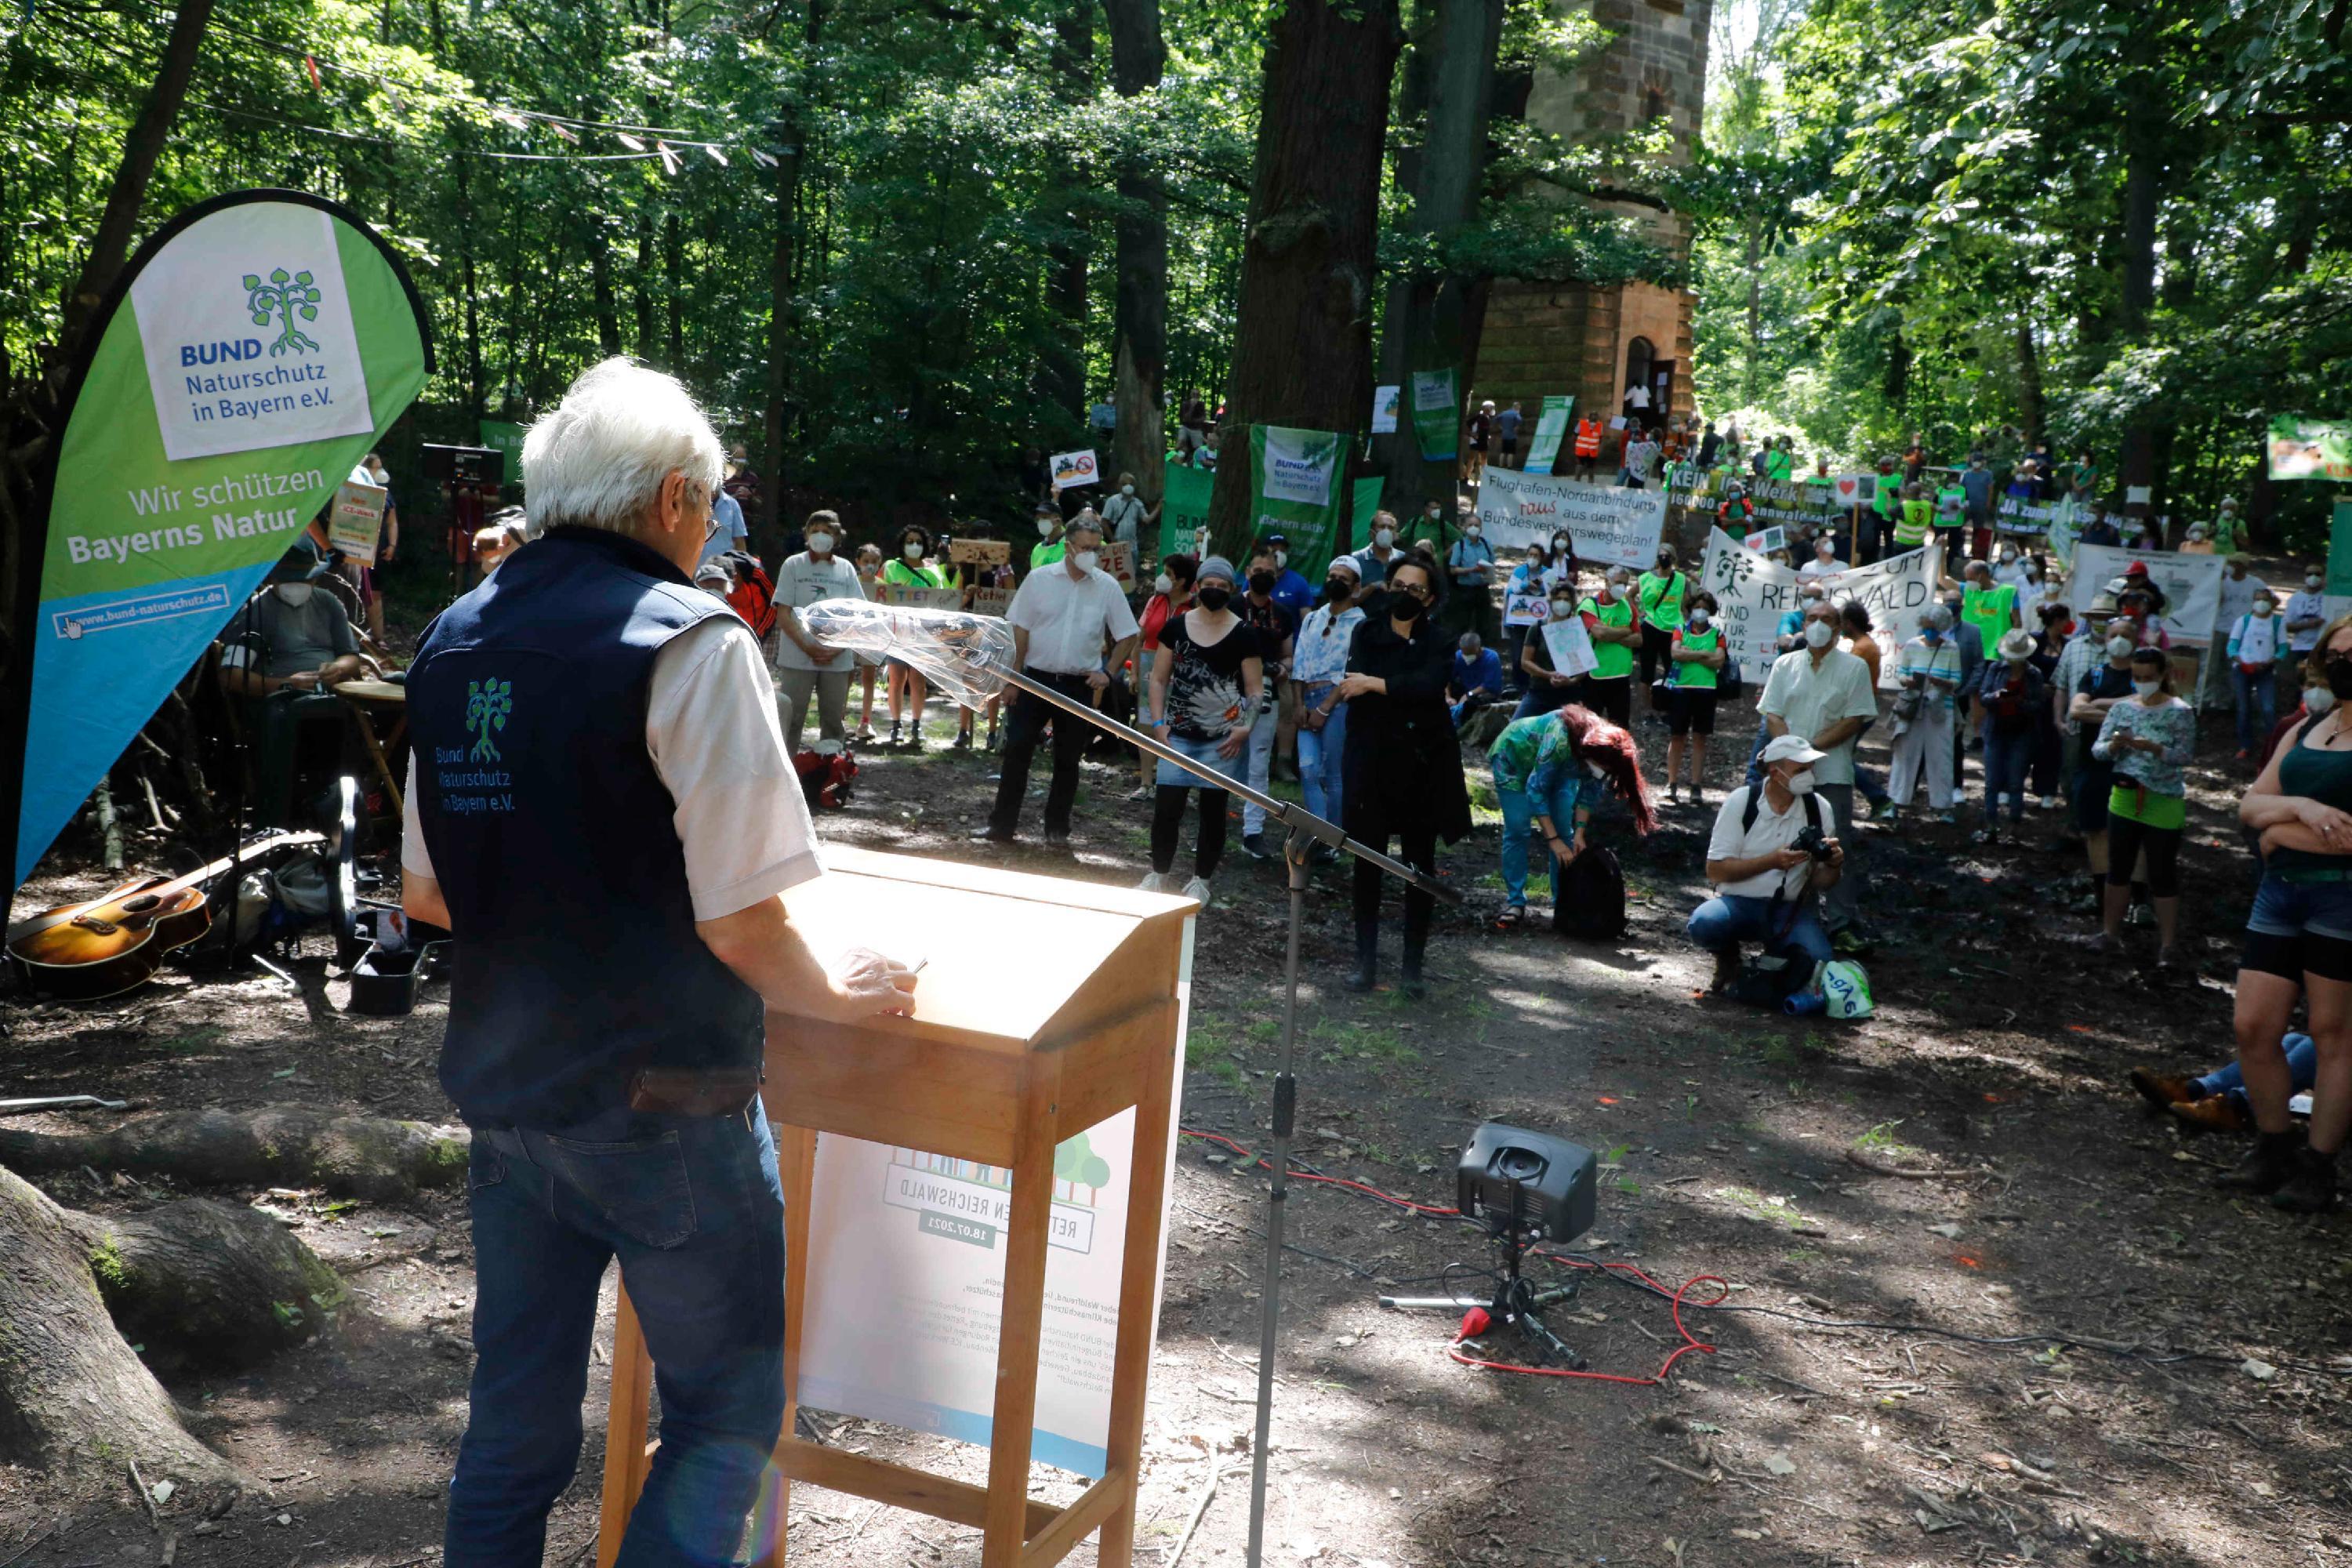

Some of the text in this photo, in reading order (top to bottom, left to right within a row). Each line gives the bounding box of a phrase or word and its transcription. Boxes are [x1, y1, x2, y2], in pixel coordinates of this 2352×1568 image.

[180, 339, 262, 367] BUND
[186, 363, 326, 395] Naturschutz
[191, 387, 334, 422] in Bayern e.V.
[128, 469, 324, 517] Wir schützen
[1489, 475, 1657, 513] Flughafen-Nordanbindung
[1671, 470, 1710, 490] KEIN
[1519, 500, 1556, 516] raus
[1671, 492, 1715, 510] 160000
[1483, 510, 1653, 547] Bundesverkehrswegeplan!
[1563, 508, 1621, 524] aus dem
[67, 523, 203, 564] Bayerns
[212, 507, 297, 541] Natur
[76, 591, 222, 627] www.bund-naturschutz.de
[1717, 603, 1750, 622] UND
[435, 745, 464, 764] Bund
[451, 793, 487, 815] Bayern
[490, 793, 516, 811] e.V.
